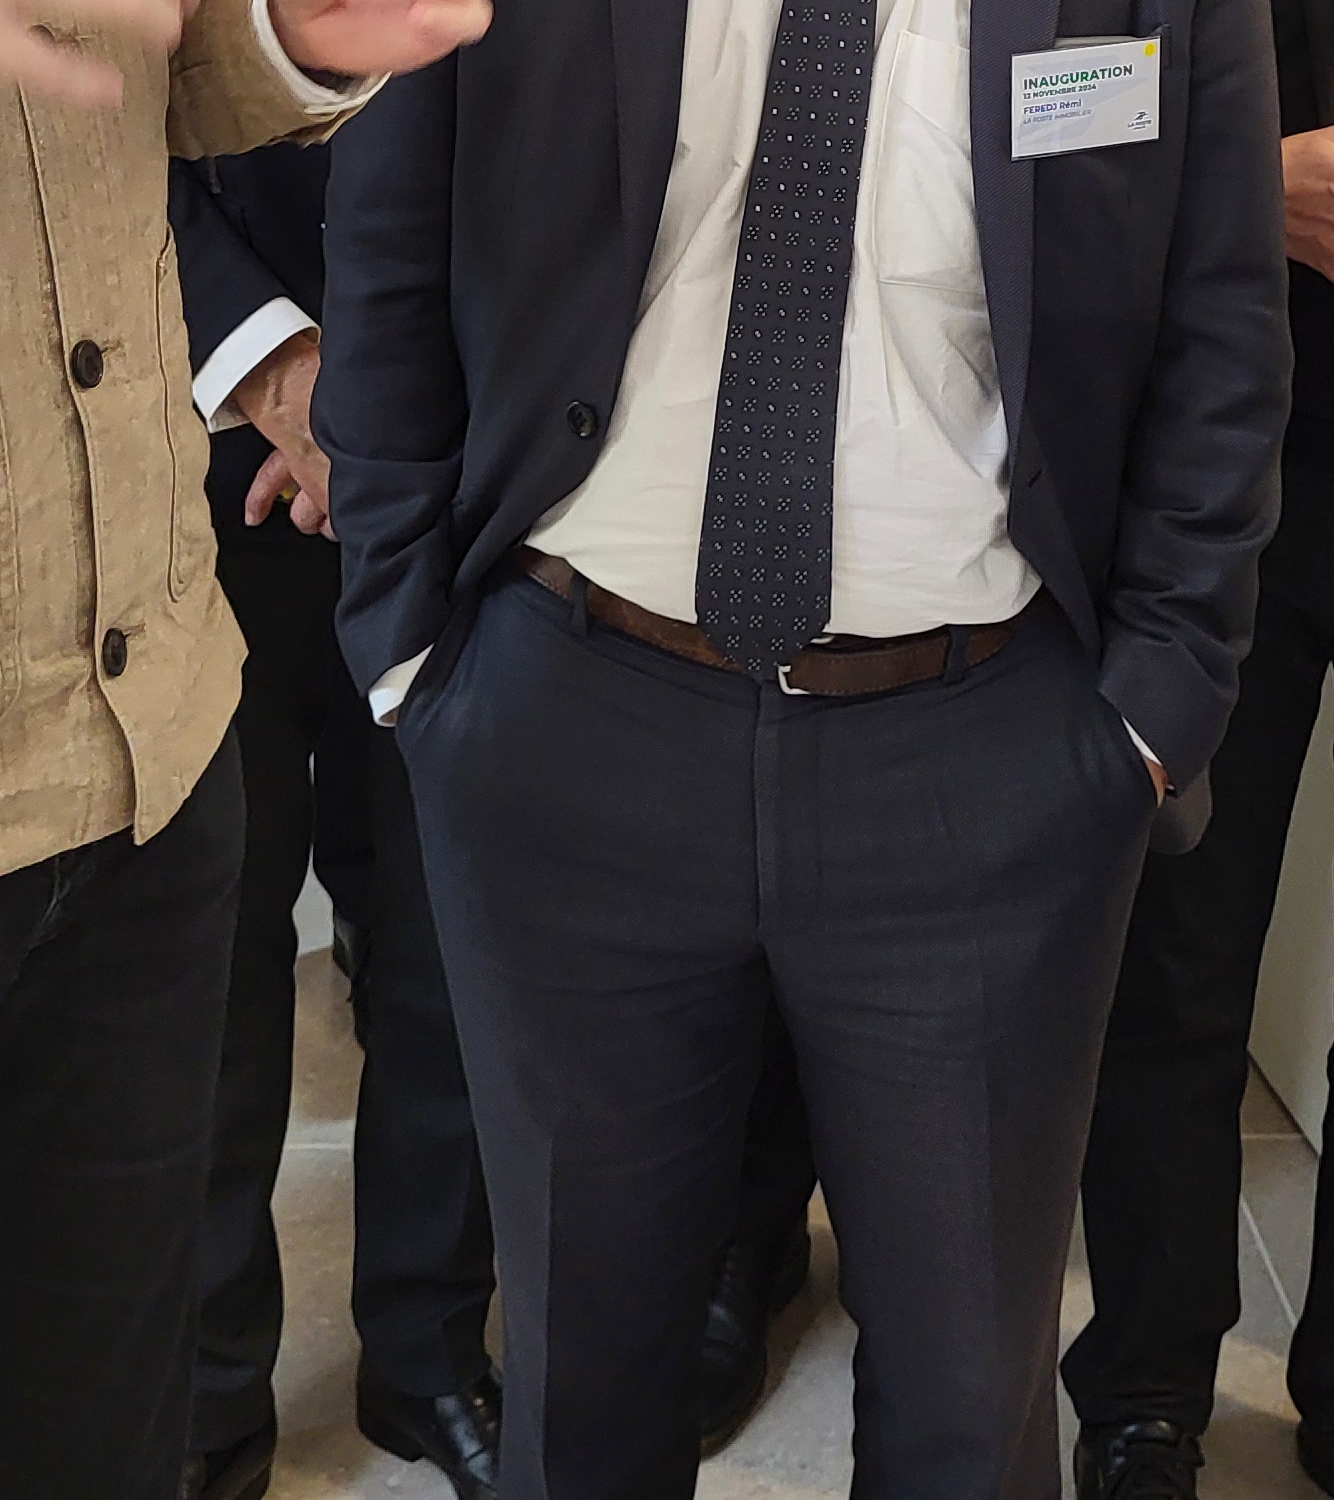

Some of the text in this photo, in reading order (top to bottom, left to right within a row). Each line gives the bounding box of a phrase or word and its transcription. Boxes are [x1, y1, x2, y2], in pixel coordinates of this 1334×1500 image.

[1023, 63, 1134, 91] INAUGURATION
[1032, 86, 1077, 99] NOVEMBRE
[1023, 102, 1057, 115] FEREDJ
